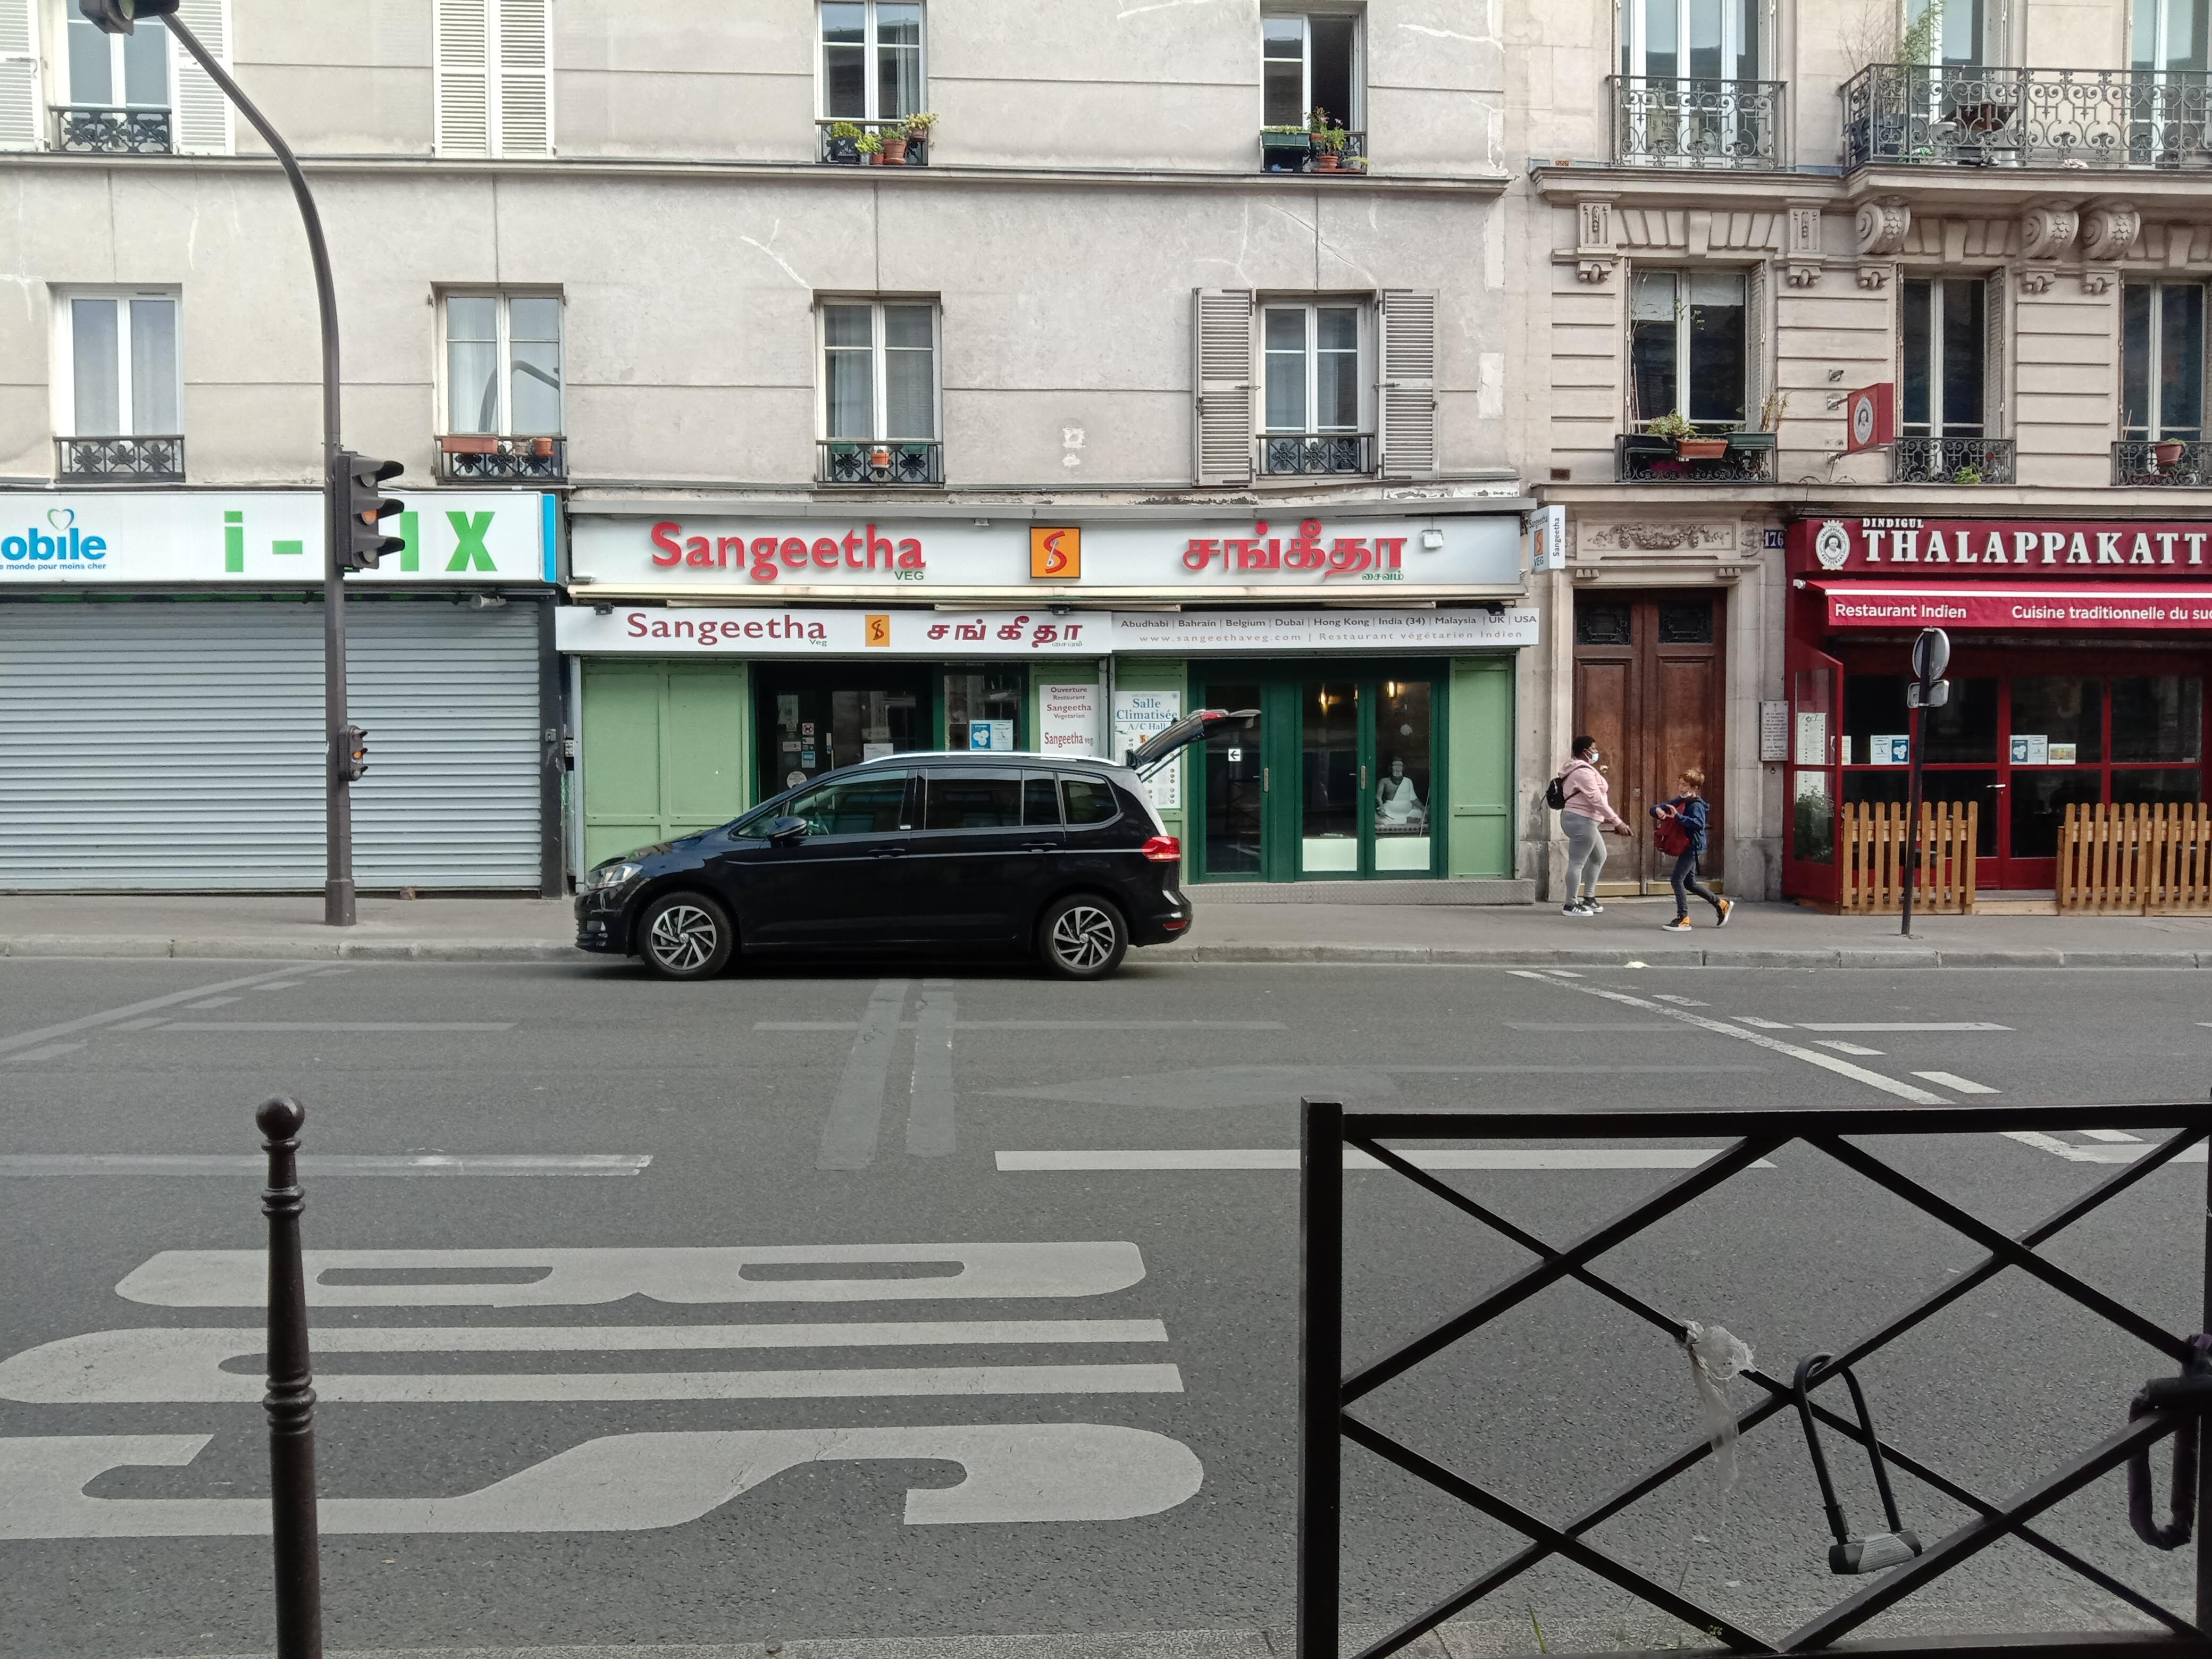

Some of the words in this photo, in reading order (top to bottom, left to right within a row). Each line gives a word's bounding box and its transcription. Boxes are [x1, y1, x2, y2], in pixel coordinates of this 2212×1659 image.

[1863, 518, 1924, 529] DINDIGUL
[1, 527, 106, 560] obile
[224, 510, 498, 572] i-IX
[1553, 517, 1562, 557] Sangeetha
[1764, 531, 1784, 547] 176
[650, 521, 926, 582] Sangeetha
[1183, 518, 1407, 581] சங்கீதா
[1862, 530, 2207, 564] THALAPPAKATT
[1534, 556, 1544, 567] VEG
[894, 571, 925, 581] VEG
[1835, 604, 1917, 617] Restaurant
[1922, 605, 1967, 618] Indien
[2012, 605, 2065, 619] Cuisine
[2069, 606, 2165, 620] traditionnelle
[2169, 606, 2189, 619] du
[627, 612, 827, 646] Sangeetha
[1226, 619, 1266, 629] Belgium
[1275, 618, 1304, 626] Dubai
[1313, 617, 1340, 627] Hong
[1344, 617, 1370, 627] Kong
[1378, 617, 1403, 625] India
[1405, 617, 1426, 626] (34)
[1435, 616, 1477, 625] Malaysia
[1514, 615, 1537, 624] USA
[808, 638, 828, 647] Veg
[1319, 632, 1394, 641] Restaurant
[1046, 703, 1092, 713] Sangeetha
[1133, 698, 1161, 708] Salle
[1117, 709, 1178, 719] Climatisée
[1044, 732, 1084, 748] Sangeetha
